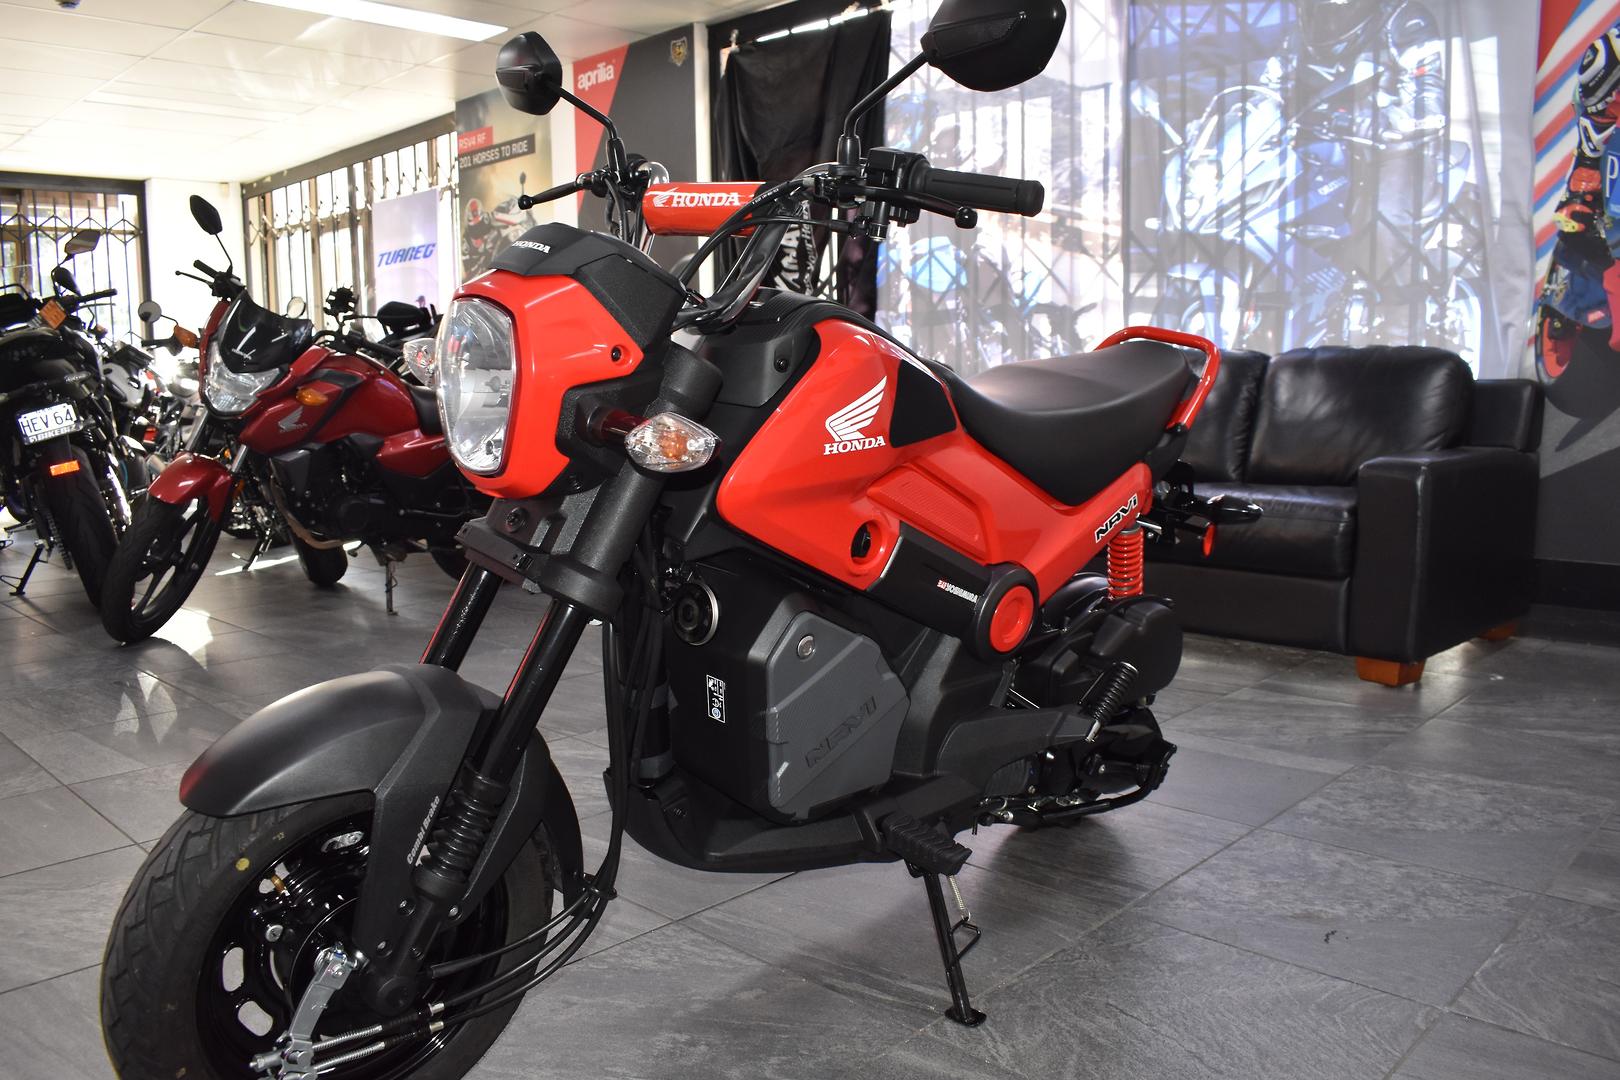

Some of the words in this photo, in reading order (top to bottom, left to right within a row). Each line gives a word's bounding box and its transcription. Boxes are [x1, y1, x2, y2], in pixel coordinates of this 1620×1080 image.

[577, 61, 614, 91] aprilia
[472, 147, 500, 165] HORSES
[501, 145, 511, 157] TO
[511, 140, 528, 155] RIDE
[671, 192, 740, 208] HONDA
[512, 241, 551, 254] HONDA
[20, 414, 50, 435] HEV
[823, 435, 886, 455] HONDA
[406, 826, 426, 865] Combi
[422, 795, 440, 830] Brake
